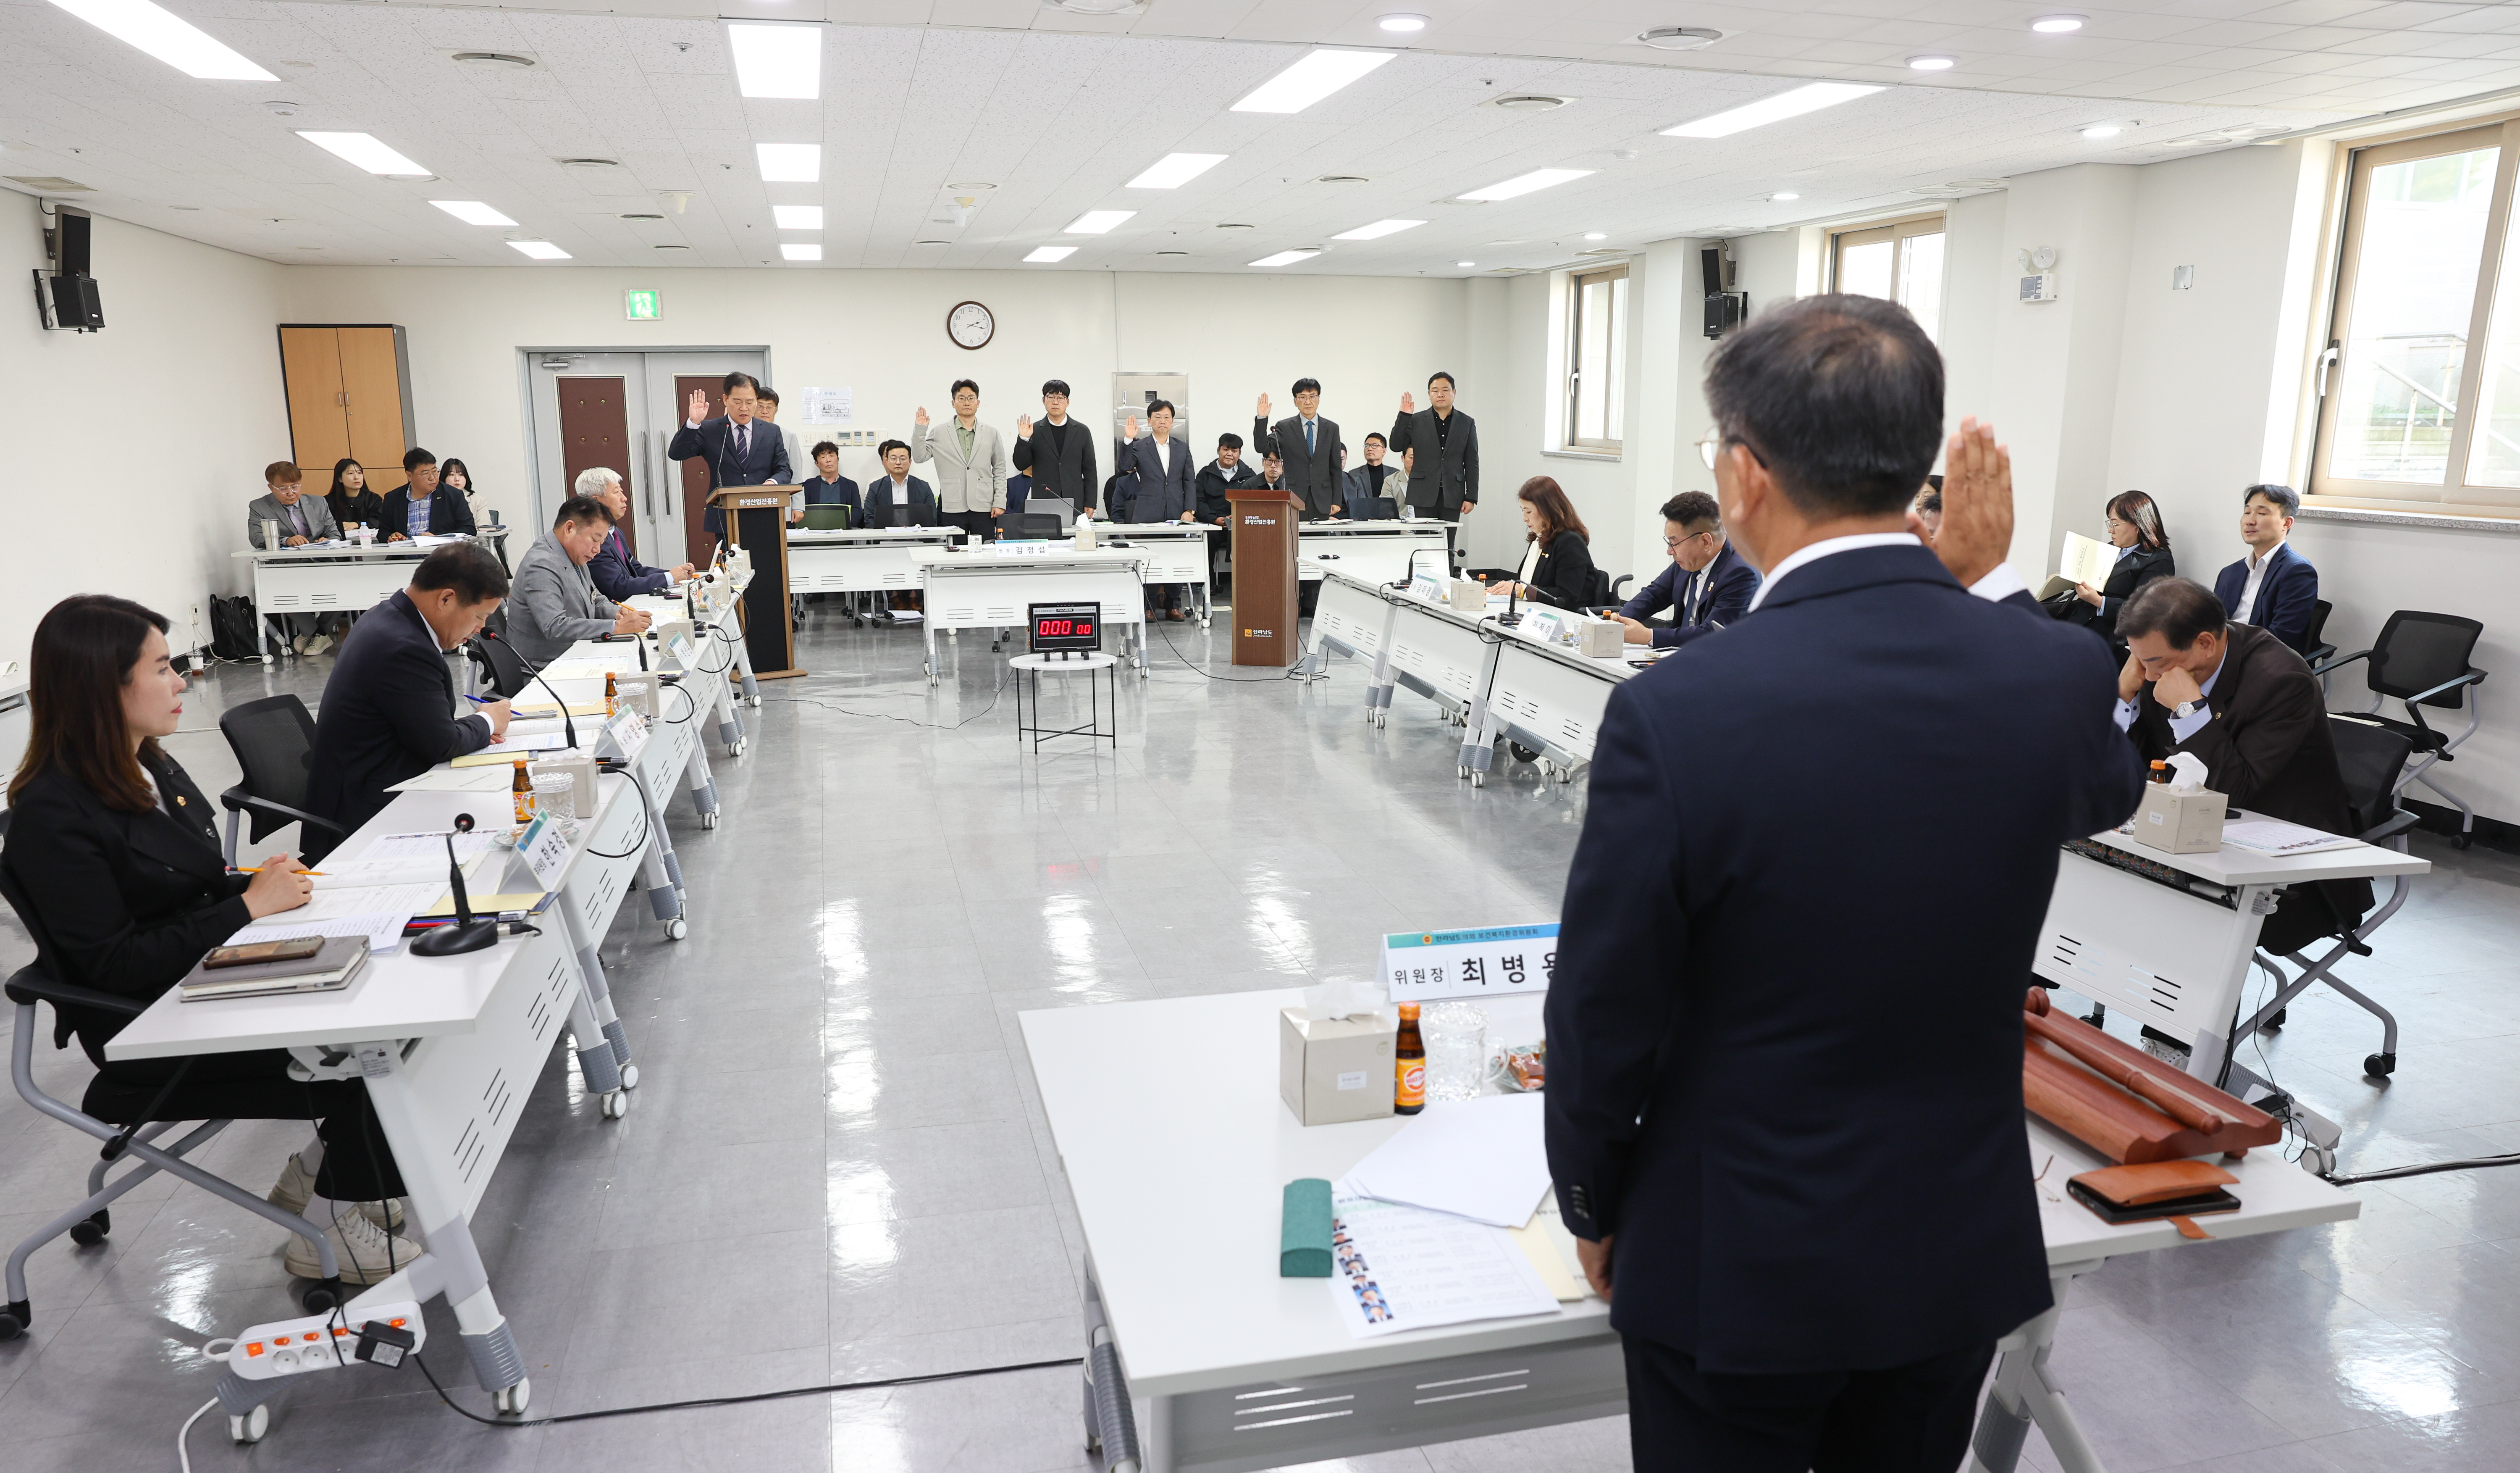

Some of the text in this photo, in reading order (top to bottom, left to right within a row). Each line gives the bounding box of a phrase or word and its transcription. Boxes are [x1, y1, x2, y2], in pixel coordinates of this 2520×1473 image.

[739, 497, 778, 506] 환경산업진흥원
[1040, 620, 1092, 636] 000 00
[540, 828, 565, 867] 한숙경
[1394, 967, 1444, 985] 위원장
